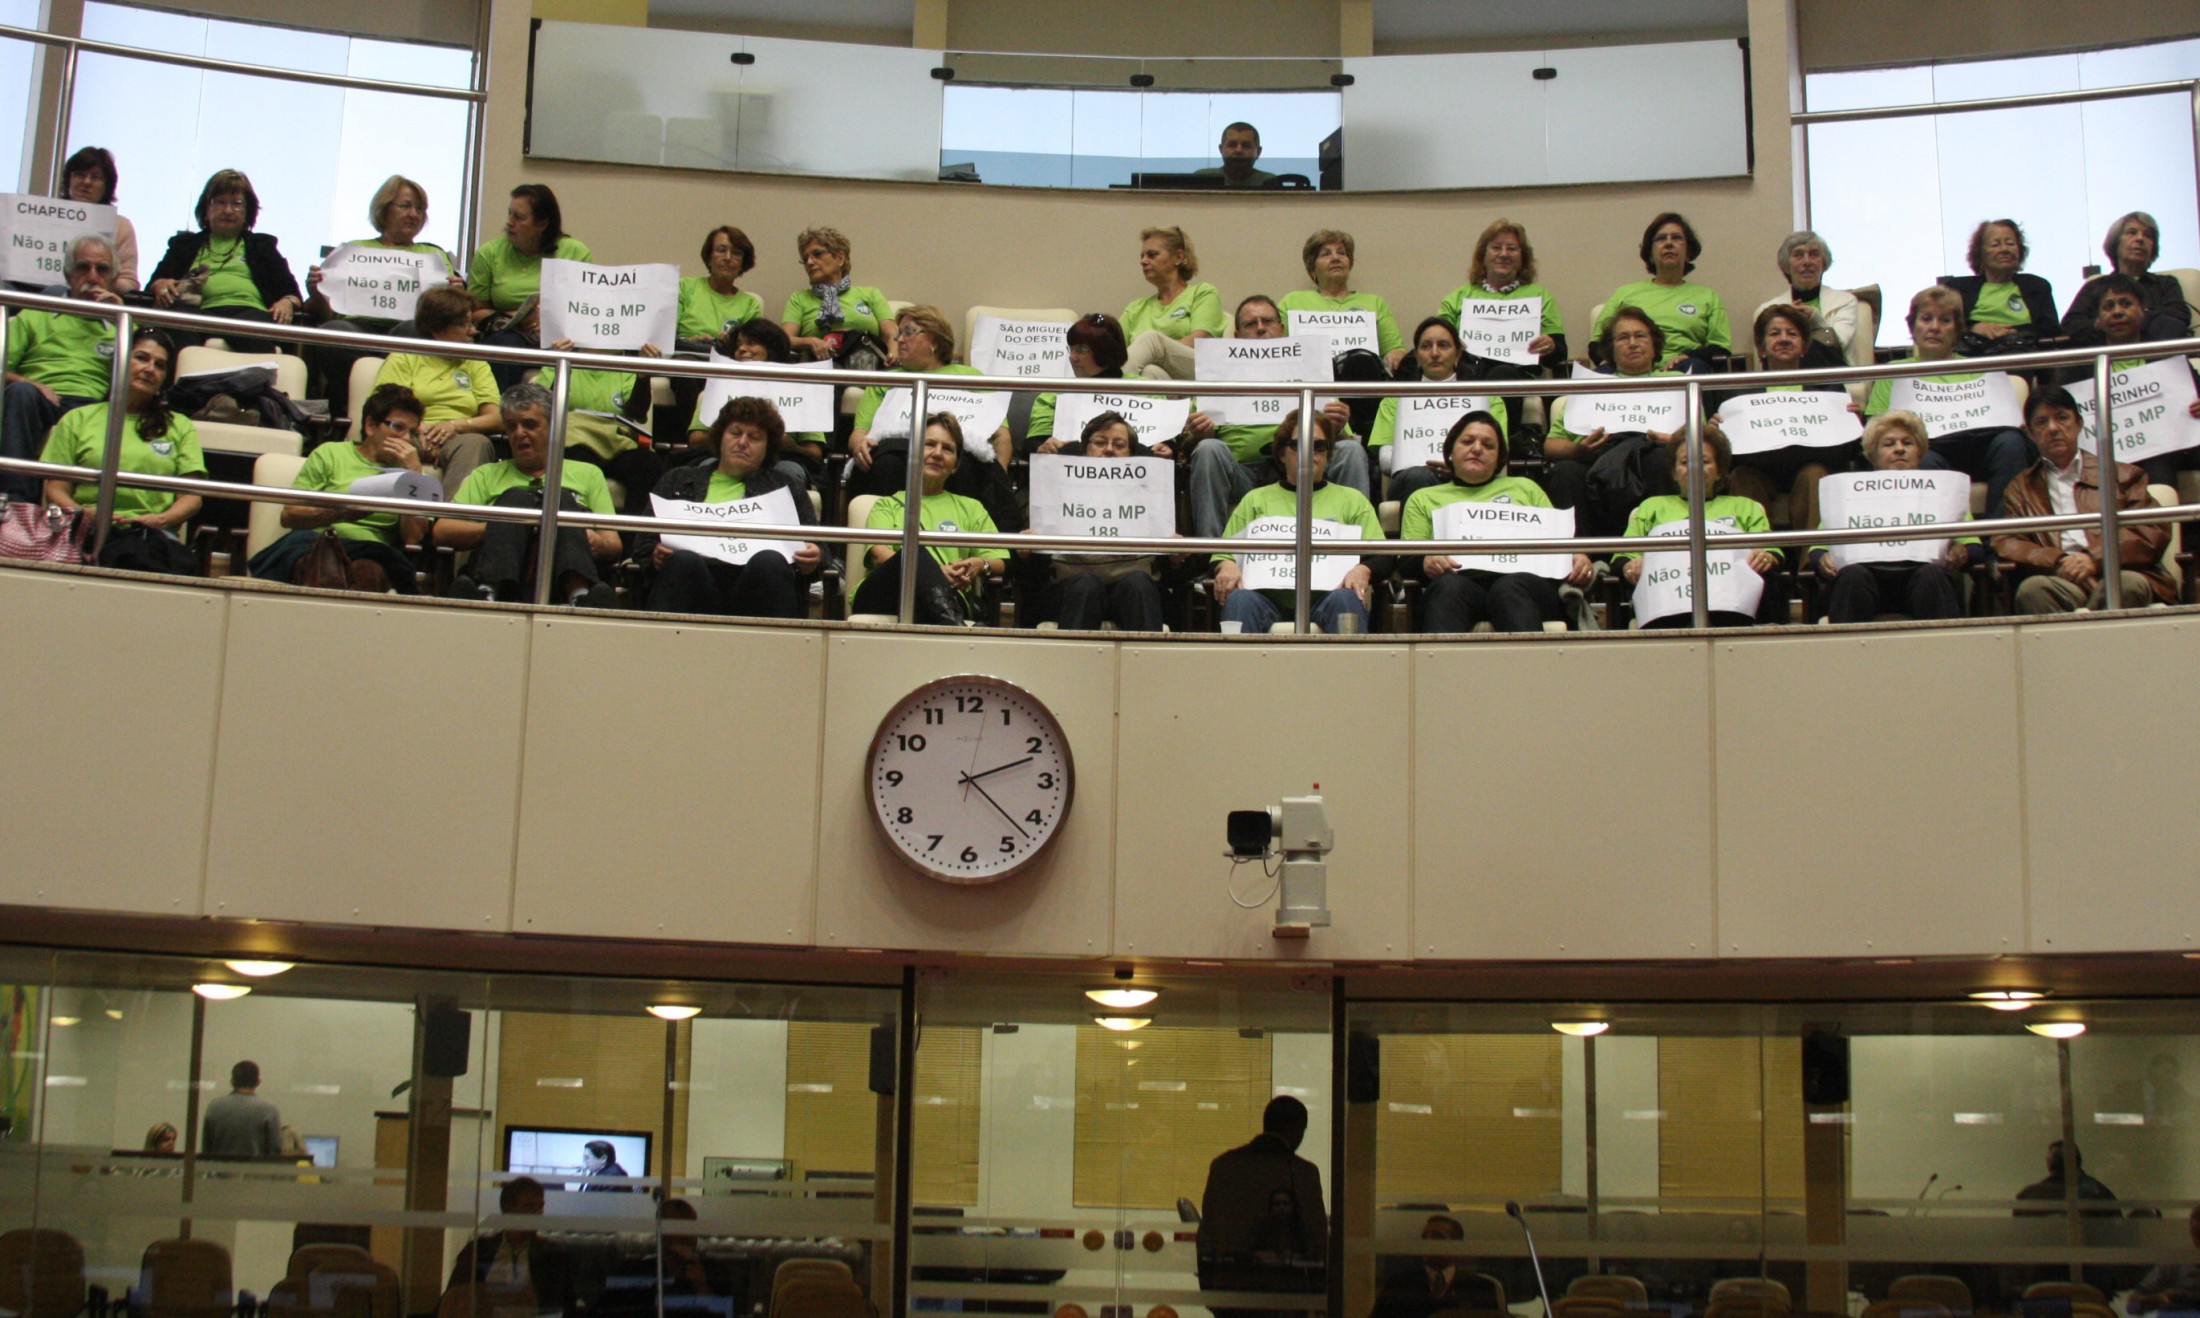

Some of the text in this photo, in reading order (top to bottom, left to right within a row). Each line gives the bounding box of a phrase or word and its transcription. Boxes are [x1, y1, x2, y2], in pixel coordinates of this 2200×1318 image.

[17, 202, 87, 221] CHAPECÓ
[13, 234, 44, 250] Não
[48, 241, 57, 252] a
[36, 257, 62, 272] 188
[348, 254, 424, 268] JOINVILLE
[348, 276, 420, 292] Não a MP
[582, 269, 637, 286] ITAJAÍ
[370, 295, 397, 309] 188
[568, 300, 646, 318] Não a MP
[1472, 304, 1531, 315] MAFRA
[1298, 314, 1366, 324] LAGUNA
[592, 323, 620, 336] 188
[999, 323, 1068, 334] SÃO MIGUEL
[1462, 329, 1535, 343] Não a MP
[1004, 335, 1062, 343] DO OESTE
[1344, 336, 1367, 346] MP
[996, 348, 1064, 361] Não a MP
[1485, 346, 1511, 357] 188
[1017, 364, 1041, 375] 188
[2109, 373, 2129, 389] IO
[778, 396, 803, 407] MP
[1093, 394, 1153, 410] RIO DO
[1413, 397, 1472, 411] LAGES
[2077, 381, 2160, 413] NERINHO
[1252, 399, 1280, 413] 188
[1595, 402, 1672, 415] Não a MP
[1965, 405, 1991, 418] MP
[1620, 414, 1647, 424] 188
[1750, 414, 1828, 429] Não a MP
[2124, 417, 2134, 428] a
[2138, 405, 2165, 424] MP
[1403, 427, 1449, 440] Não a
[1780, 427, 1808, 437] 188
[1939, 421, 1969, 431] 188
[2116, 432, 2146, 450] 188
[1064, 463, 1146, 479] TUBARÃO
[1853, 476, 1936, 492] CRICIÚMA
[683, 502, 763, 517] JOAÇABA
[1062, 502, 1146, 519] Não a MP
[1466, 508, 1542, 524] VIDEIRA
[1848, 512, 1936, 528] Não a MP
[719, 542, 748, 554] 188
[1648, 568, 1680, 586] Não
[955, 696, 984, 713] 12
[923, 708, 944, 725] 11
[1001, 709, 1010, 726] 1
[896, 734, 927, 752] 10
[1025, 736, 1043, 754] 2
[885, 770, 904, 787] 9
[1037, 772, 1054, 790] 3
[897, 806, 914, 824] 8
[1025, 809, 1043, 825] 4
[927, 835, 944, 851] 7
[999, 836, 1016, 853] 5
[960, 846, 978, 863] 6
